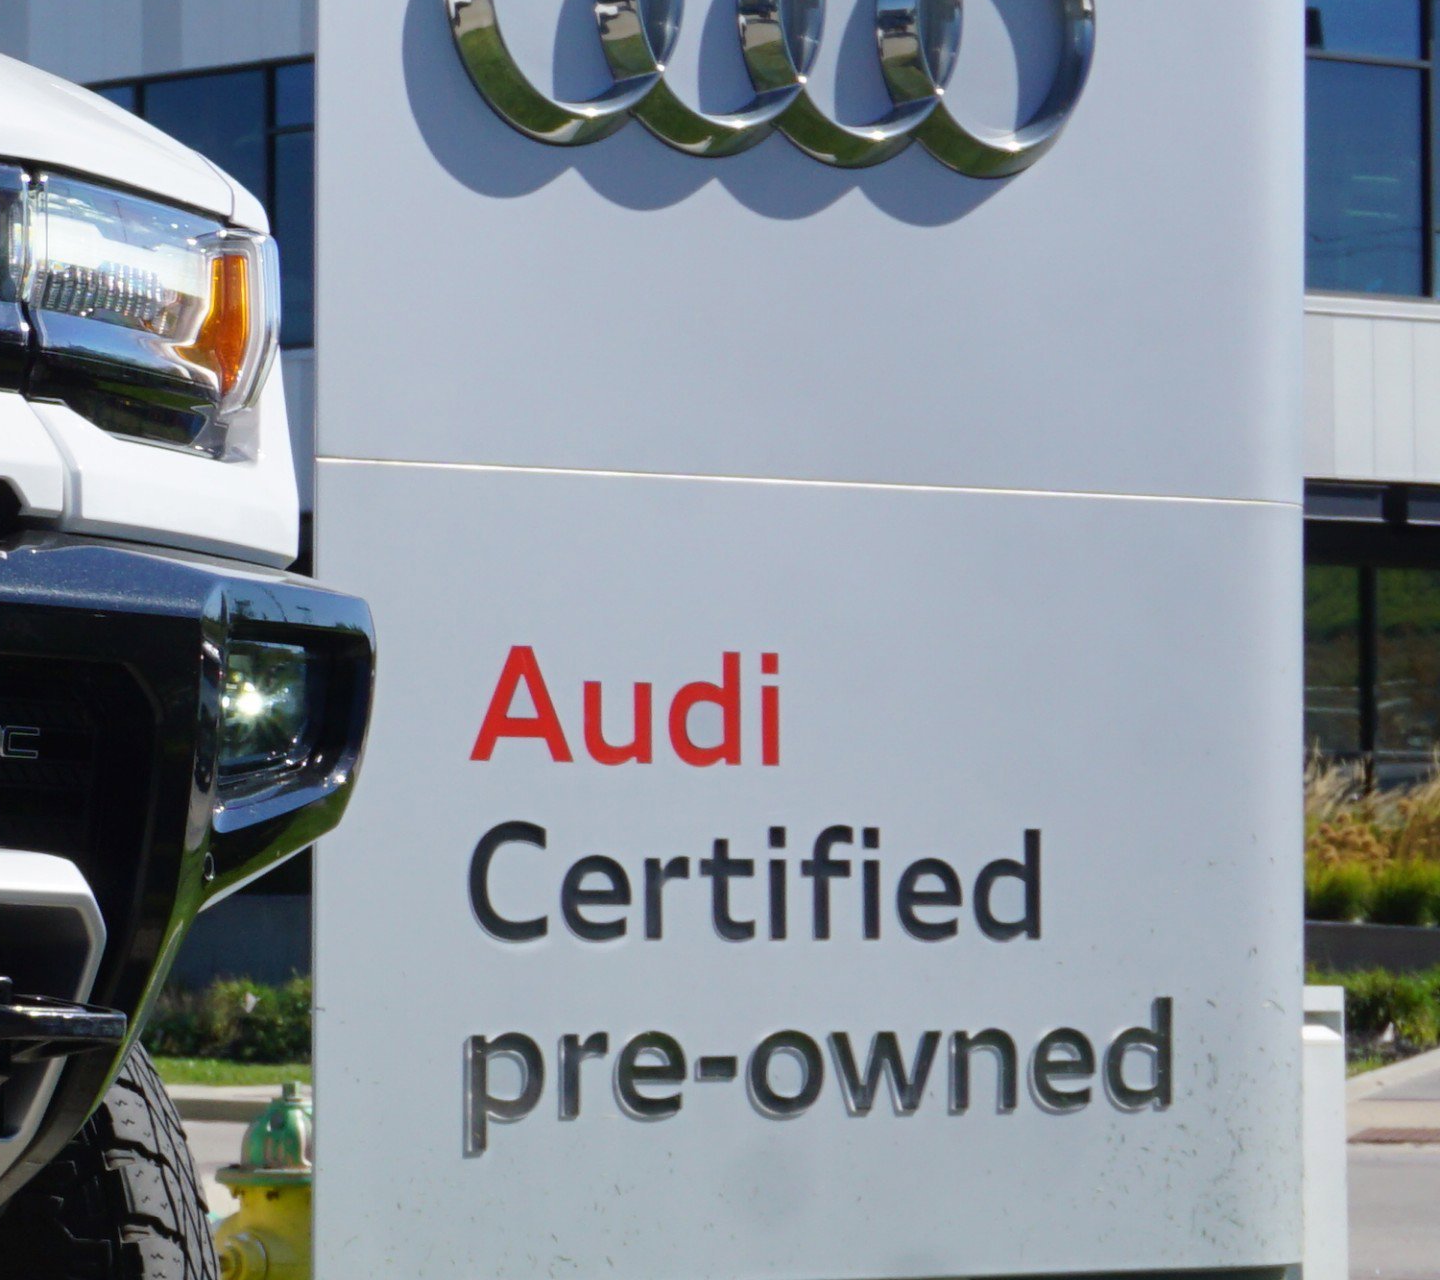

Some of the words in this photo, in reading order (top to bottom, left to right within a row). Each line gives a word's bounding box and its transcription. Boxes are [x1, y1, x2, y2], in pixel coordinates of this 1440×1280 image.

[470, 645, 779, 767] Audi
[467, 820, 1041, 943] Certified
[462, 996, 1173, 1158] pre-owned
